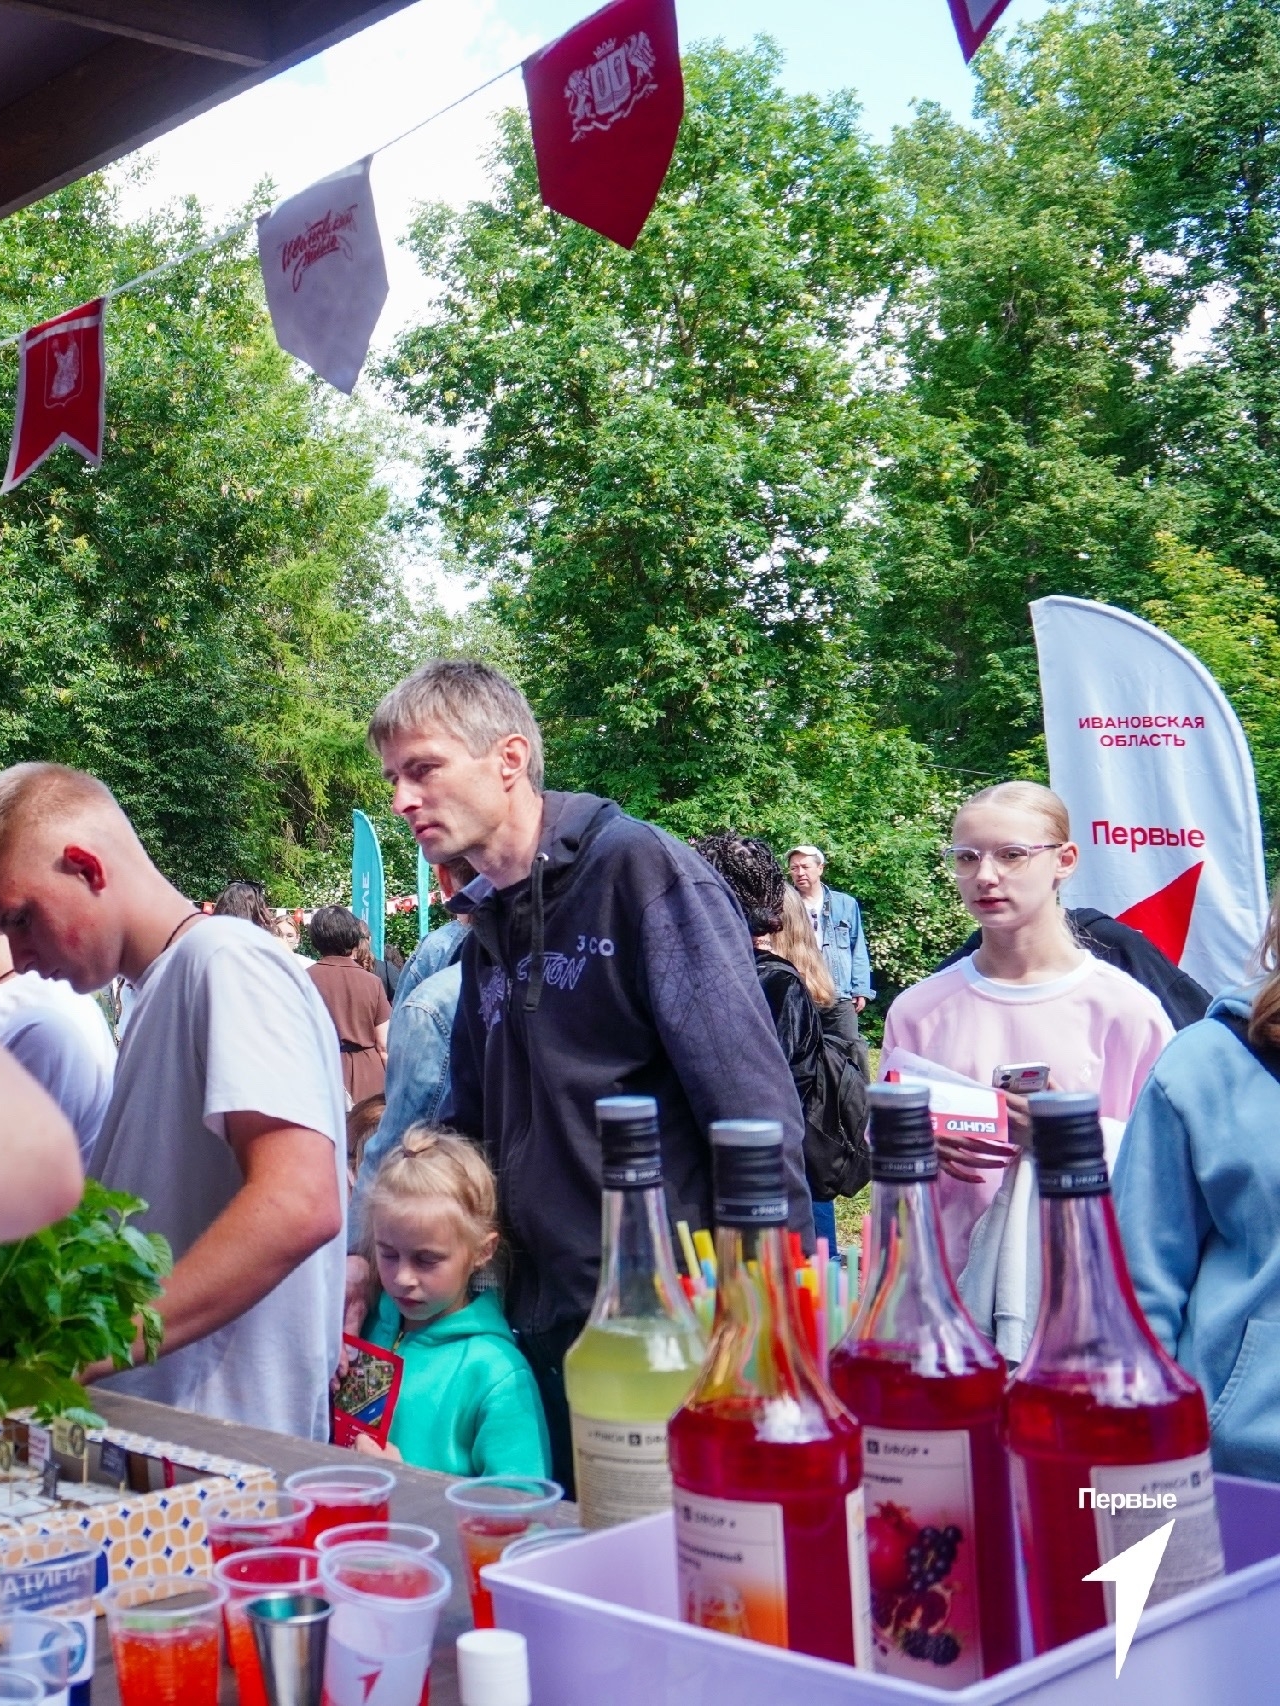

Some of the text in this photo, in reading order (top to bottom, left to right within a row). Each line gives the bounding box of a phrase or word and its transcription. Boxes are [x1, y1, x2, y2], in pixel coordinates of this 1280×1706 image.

[1078, 716, 1205, 730] ИВАНОВСКАЯ
[1100, 733, 1186, 747] ОБЛАСТЬ
[1091, 820, 1205, 853] Первые
[946, 1119, 996, 1134] БИНГО
